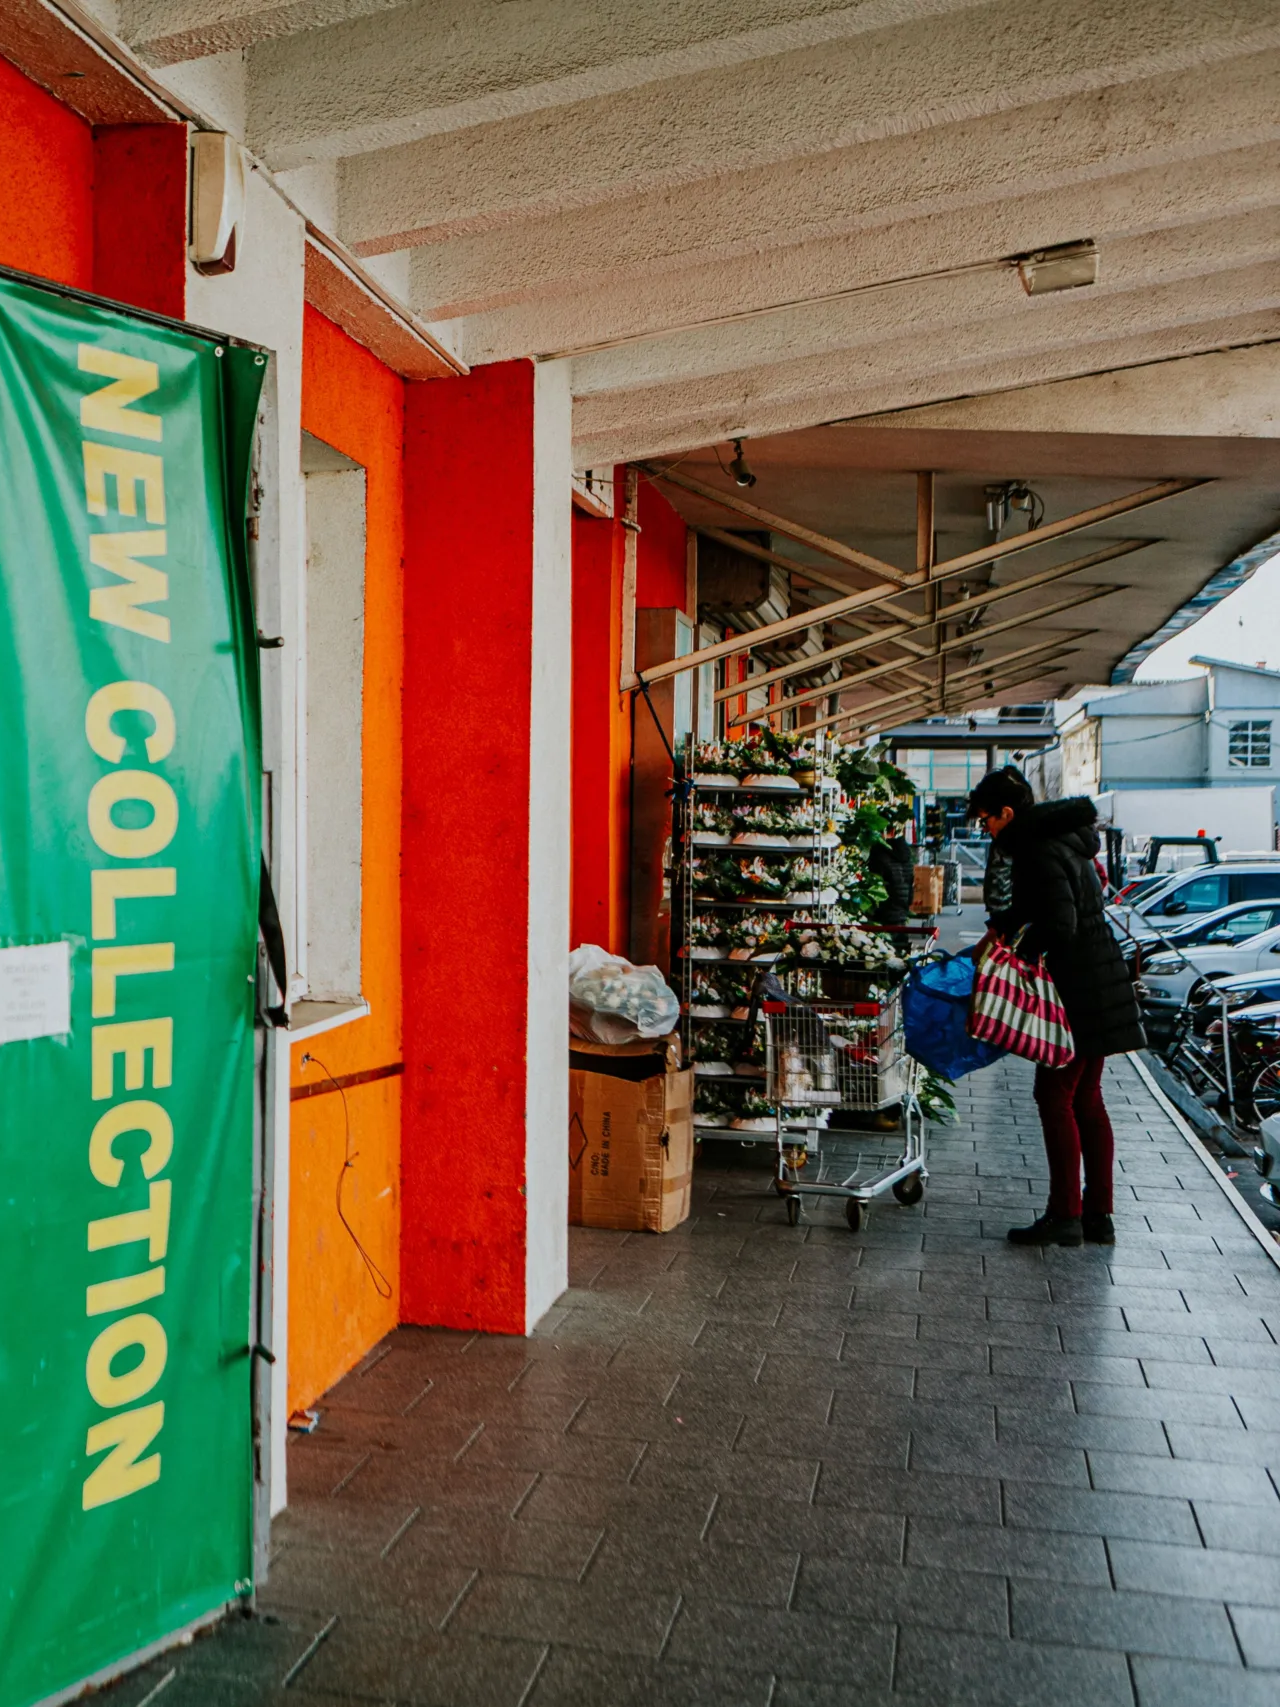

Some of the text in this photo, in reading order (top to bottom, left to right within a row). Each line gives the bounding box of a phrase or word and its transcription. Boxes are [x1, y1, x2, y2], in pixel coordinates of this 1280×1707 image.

[77, 342, 179, 1512] NEW COLLECTION
[600, 1111, 611, 1177] MADE IN CHINA
